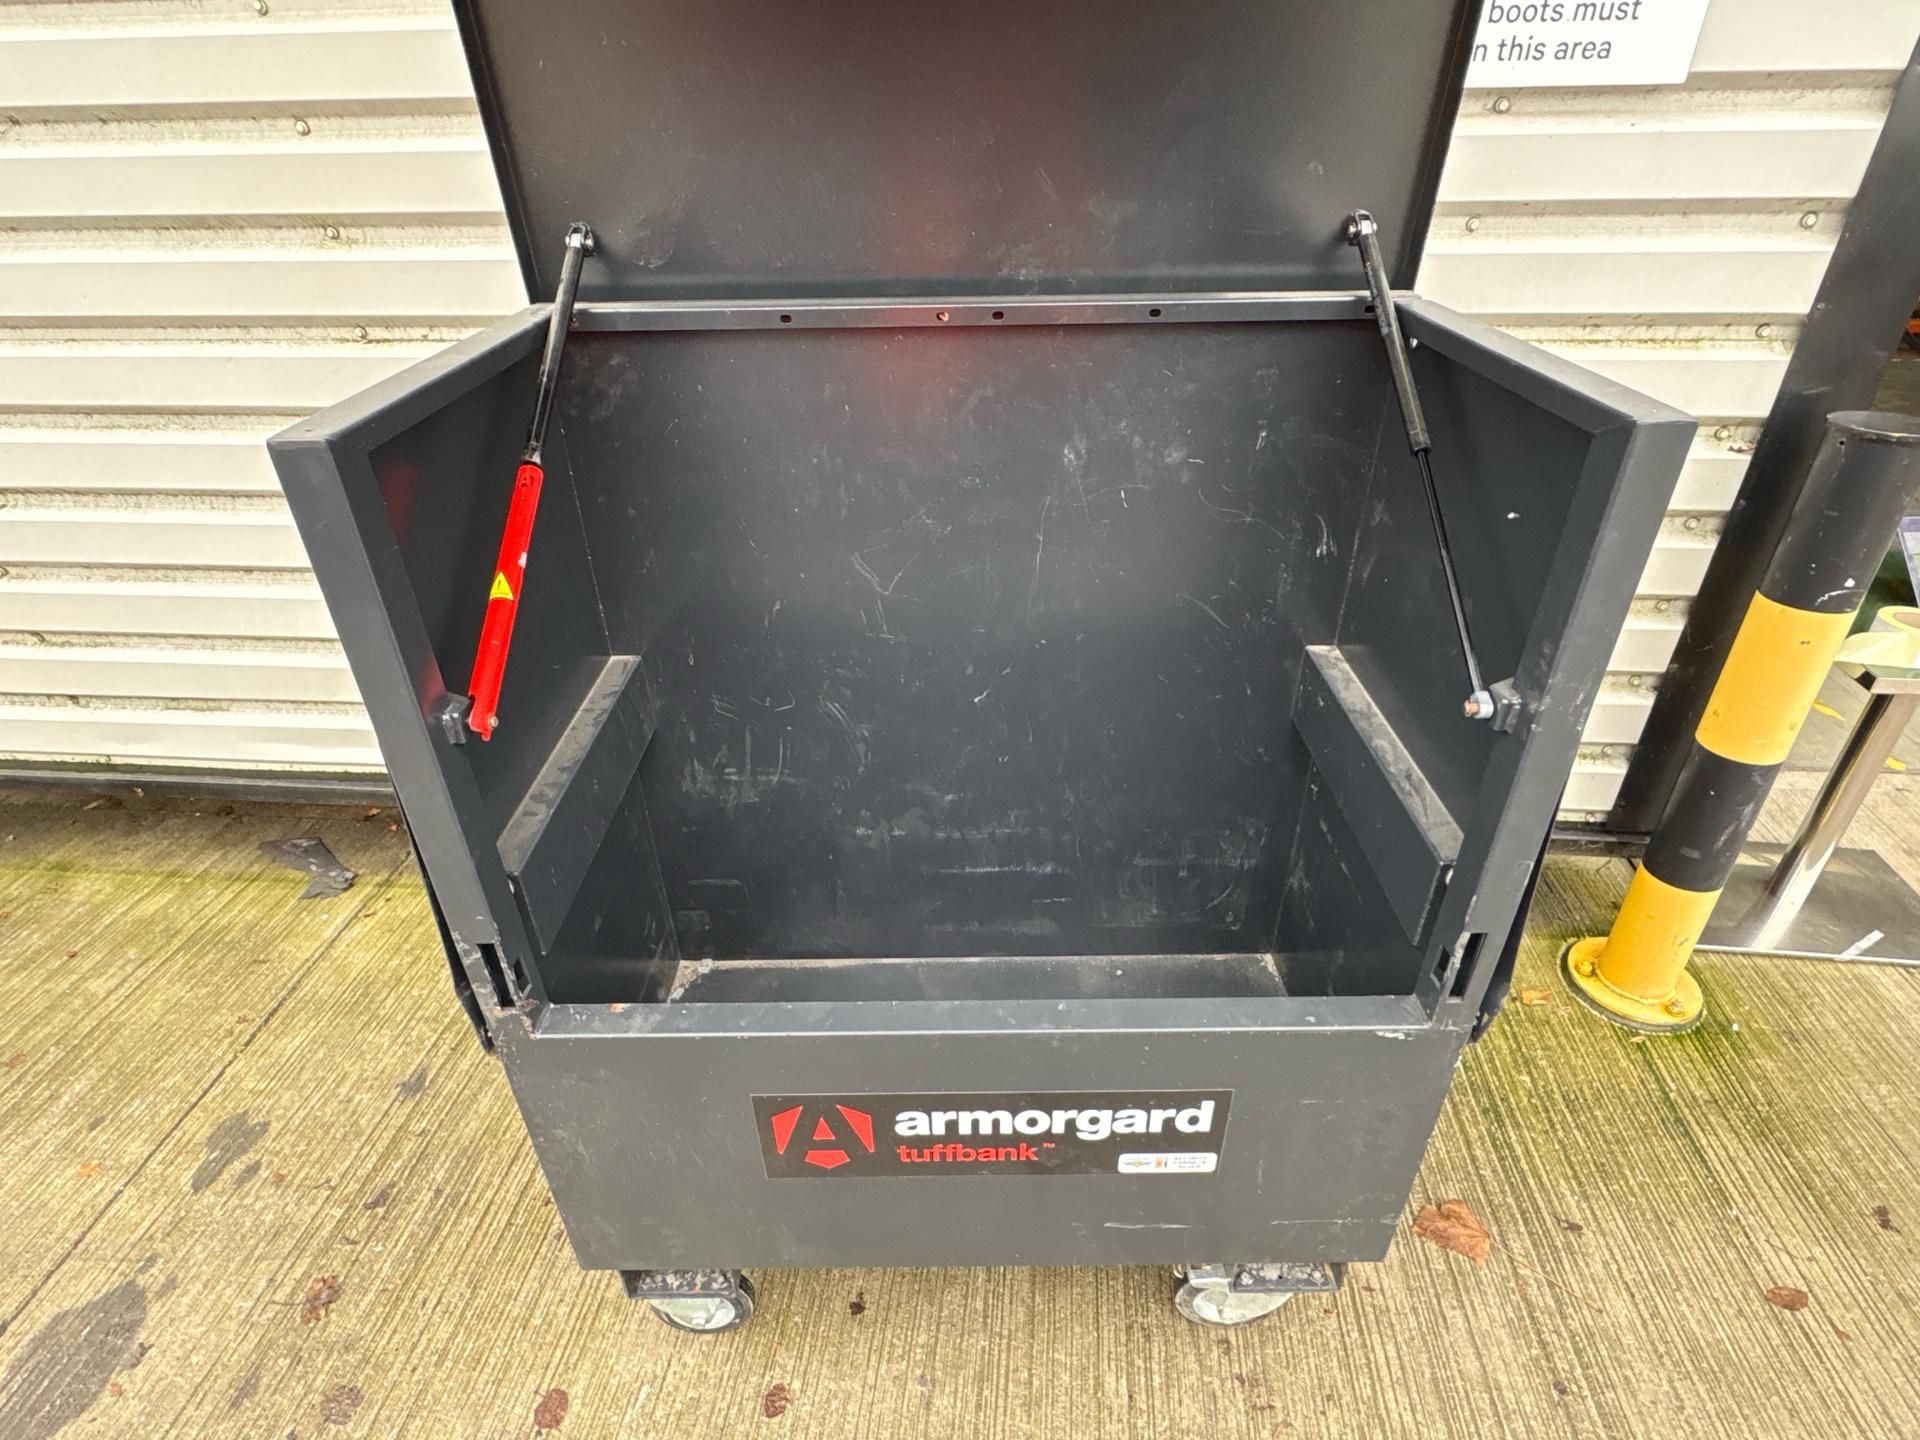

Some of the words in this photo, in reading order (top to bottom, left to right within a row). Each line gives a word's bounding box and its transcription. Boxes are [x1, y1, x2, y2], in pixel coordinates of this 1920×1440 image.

[1488, 0, 1564, 23] boots
[1572, 0, 1642, 21] must
[1473, 43, 1487, 62] n
[1497, 35, 1546, 61] this
[1554, 41, 1612, 60] area
[895, 1100, 1215, 1140] armorgard
[897, 1143, 1039, 1162] tuffbank
